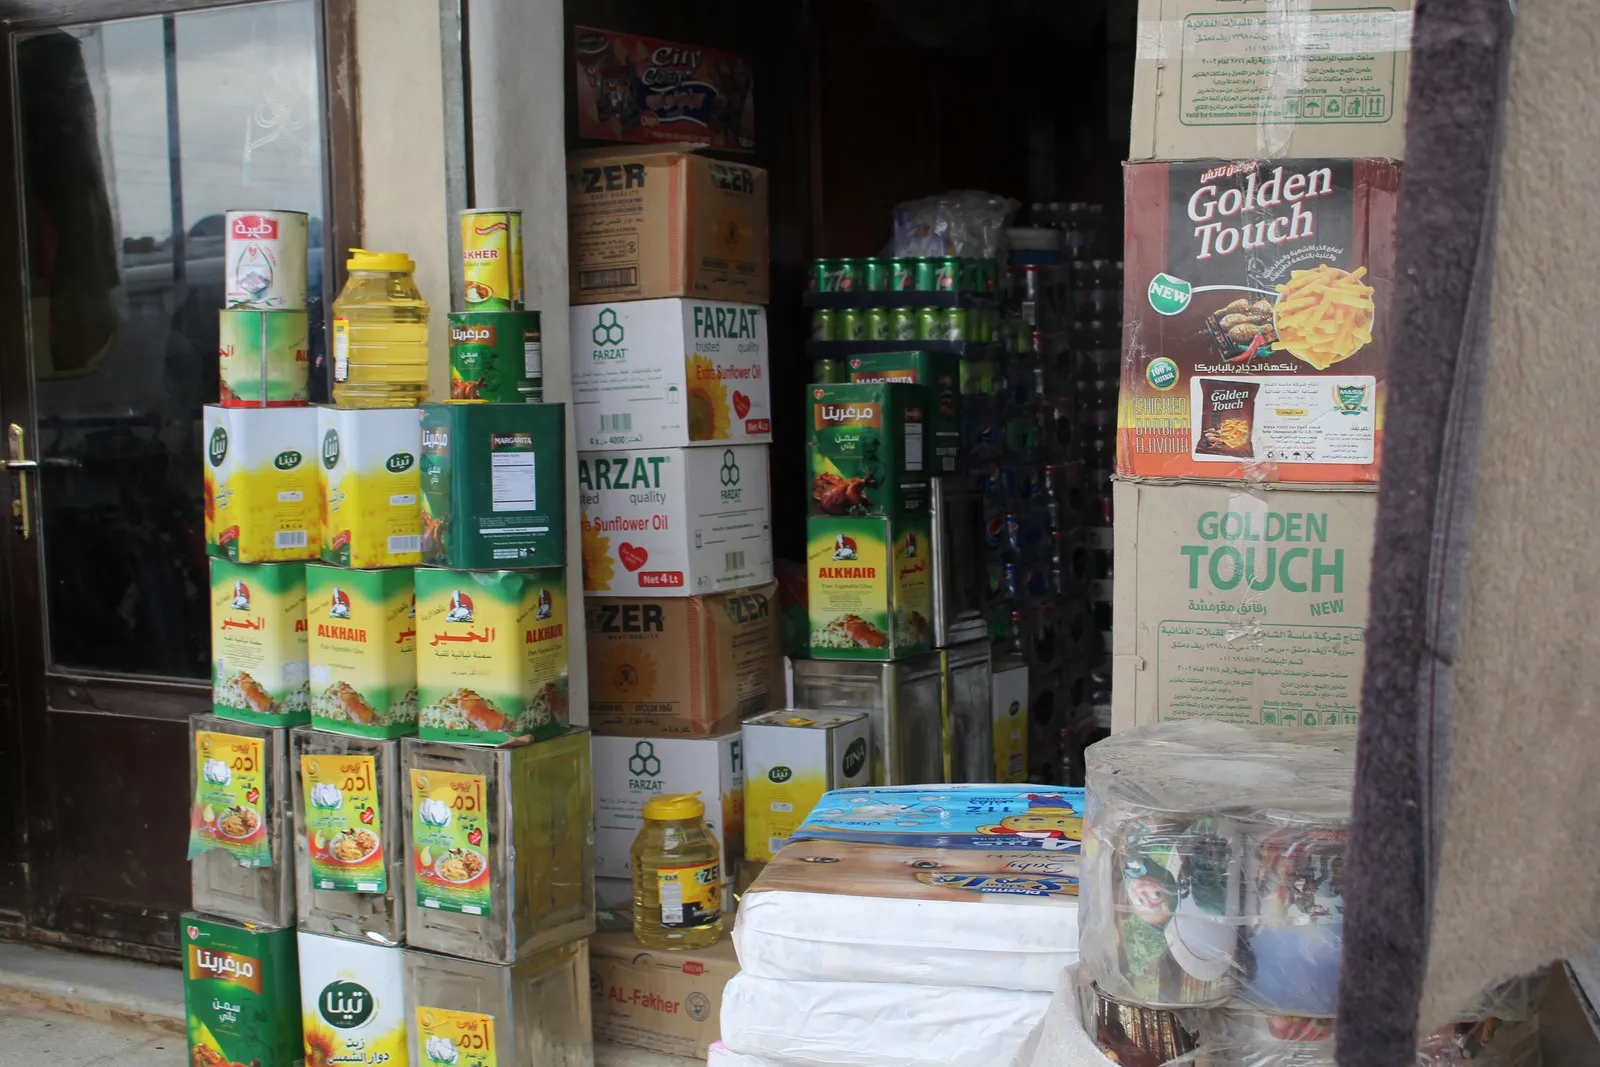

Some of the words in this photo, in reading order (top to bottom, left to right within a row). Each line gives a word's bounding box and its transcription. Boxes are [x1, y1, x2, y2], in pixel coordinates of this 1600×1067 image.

[582, 163, 645, 193] ZER
[1187, 166, 1334, 222] Golden
[1194, 201, 1313, 260] Touch
[1150, 281, 1190, 307] NEW
[693, 306, 759, 339] FARZAT
[592, 348, 628, 361] FARZAT
[1262, 363, 1298, 374] بنكهة
[1211, 389, 1249, 403] Golden
[821, 405, 874, 422] مرغريتا
[1135, 396, 1187, 416] CHICKEN
[1212, 400, 1244, 412] Touch
[1135, 436, 1190, 455] FLAVOUR
[390, 455, 411, 469] تينا
[629, 490, 667, 506] quality
[594, 516, 649, 532] Sunflower
[652, 514, 669, 531] Oil
[1197, 511, 1328, 543] GOLDEN
[818, 567, 876, 579] ALKHAIR
[1180, 545, 1345, 593] TOUCH
[643, 575, 660, 585] Net
[660, 573, 669, 584] 4
[1309, 599, 1345, 618] NEW
[600, 603, 664, 633] ZER
[317, 623, 368, 643] ALKHAIR
[430, 625, 496, 647] الخير
[525, 623, 563, 645] ALKHAIR
[628, 778, 665, 791] FARZAT
[1036, 838, 1080, 851] 4
[1002, 862, 1064, 874] Baby
[196, 948, 255, 978] مرغريتا
[212, 998, 241, 1013] سمن
[325, 990, 366, 1020] تينا
[608, 984, 680, 1015] AL-Fakher
[345, 1038, 366, 1051] زيت
[328, 1049, 367, 1065] الشمس
[367, 1051, 390, 1065] دوار
